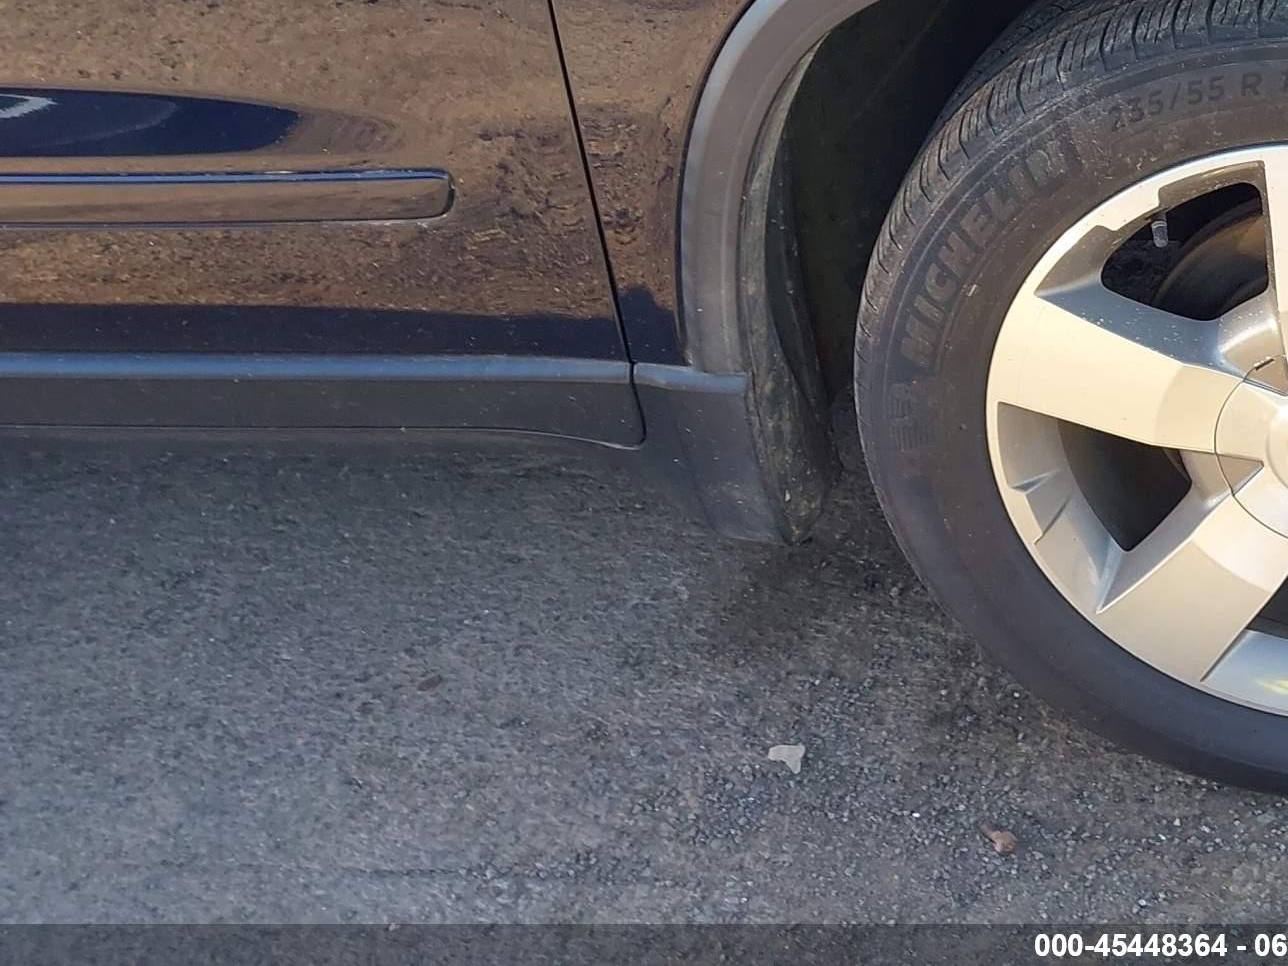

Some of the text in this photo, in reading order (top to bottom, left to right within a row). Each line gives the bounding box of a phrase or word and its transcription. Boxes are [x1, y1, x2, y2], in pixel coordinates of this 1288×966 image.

[1107, 74, 1225, 132] 235/55
[1240, 72, 1263, 98] R
[900, 139, 1070, 369] MICHELIN
